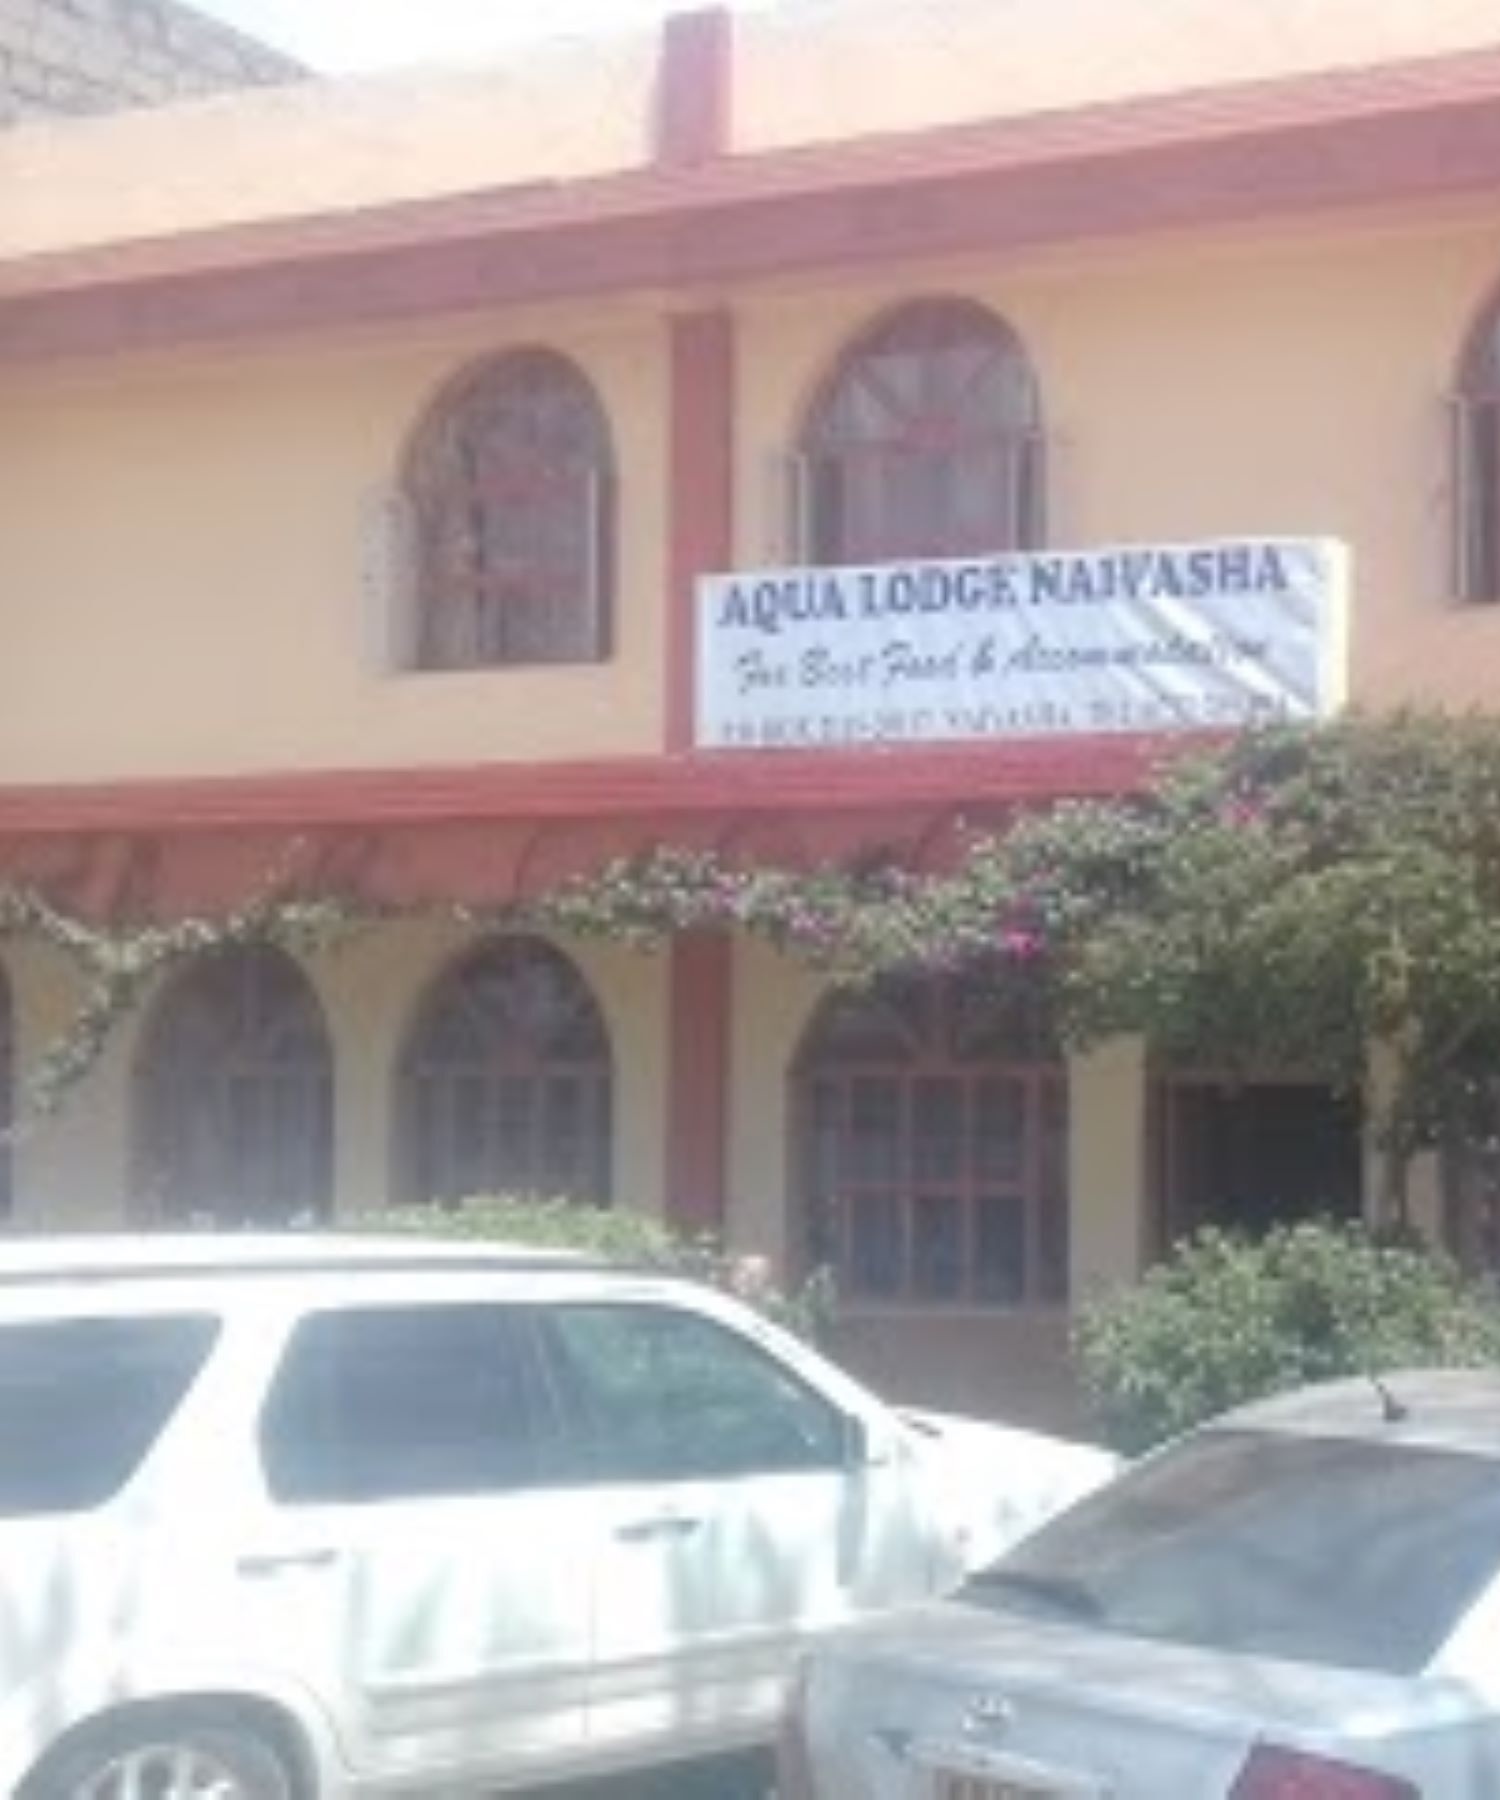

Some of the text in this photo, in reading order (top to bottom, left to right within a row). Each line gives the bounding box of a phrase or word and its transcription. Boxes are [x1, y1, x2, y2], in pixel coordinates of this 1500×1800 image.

[718, 545, 1288, 634] AQUA LODGE NAIVASHA
[800, 644, 874, 687] Best
[881, 637, 962, 687] Food
